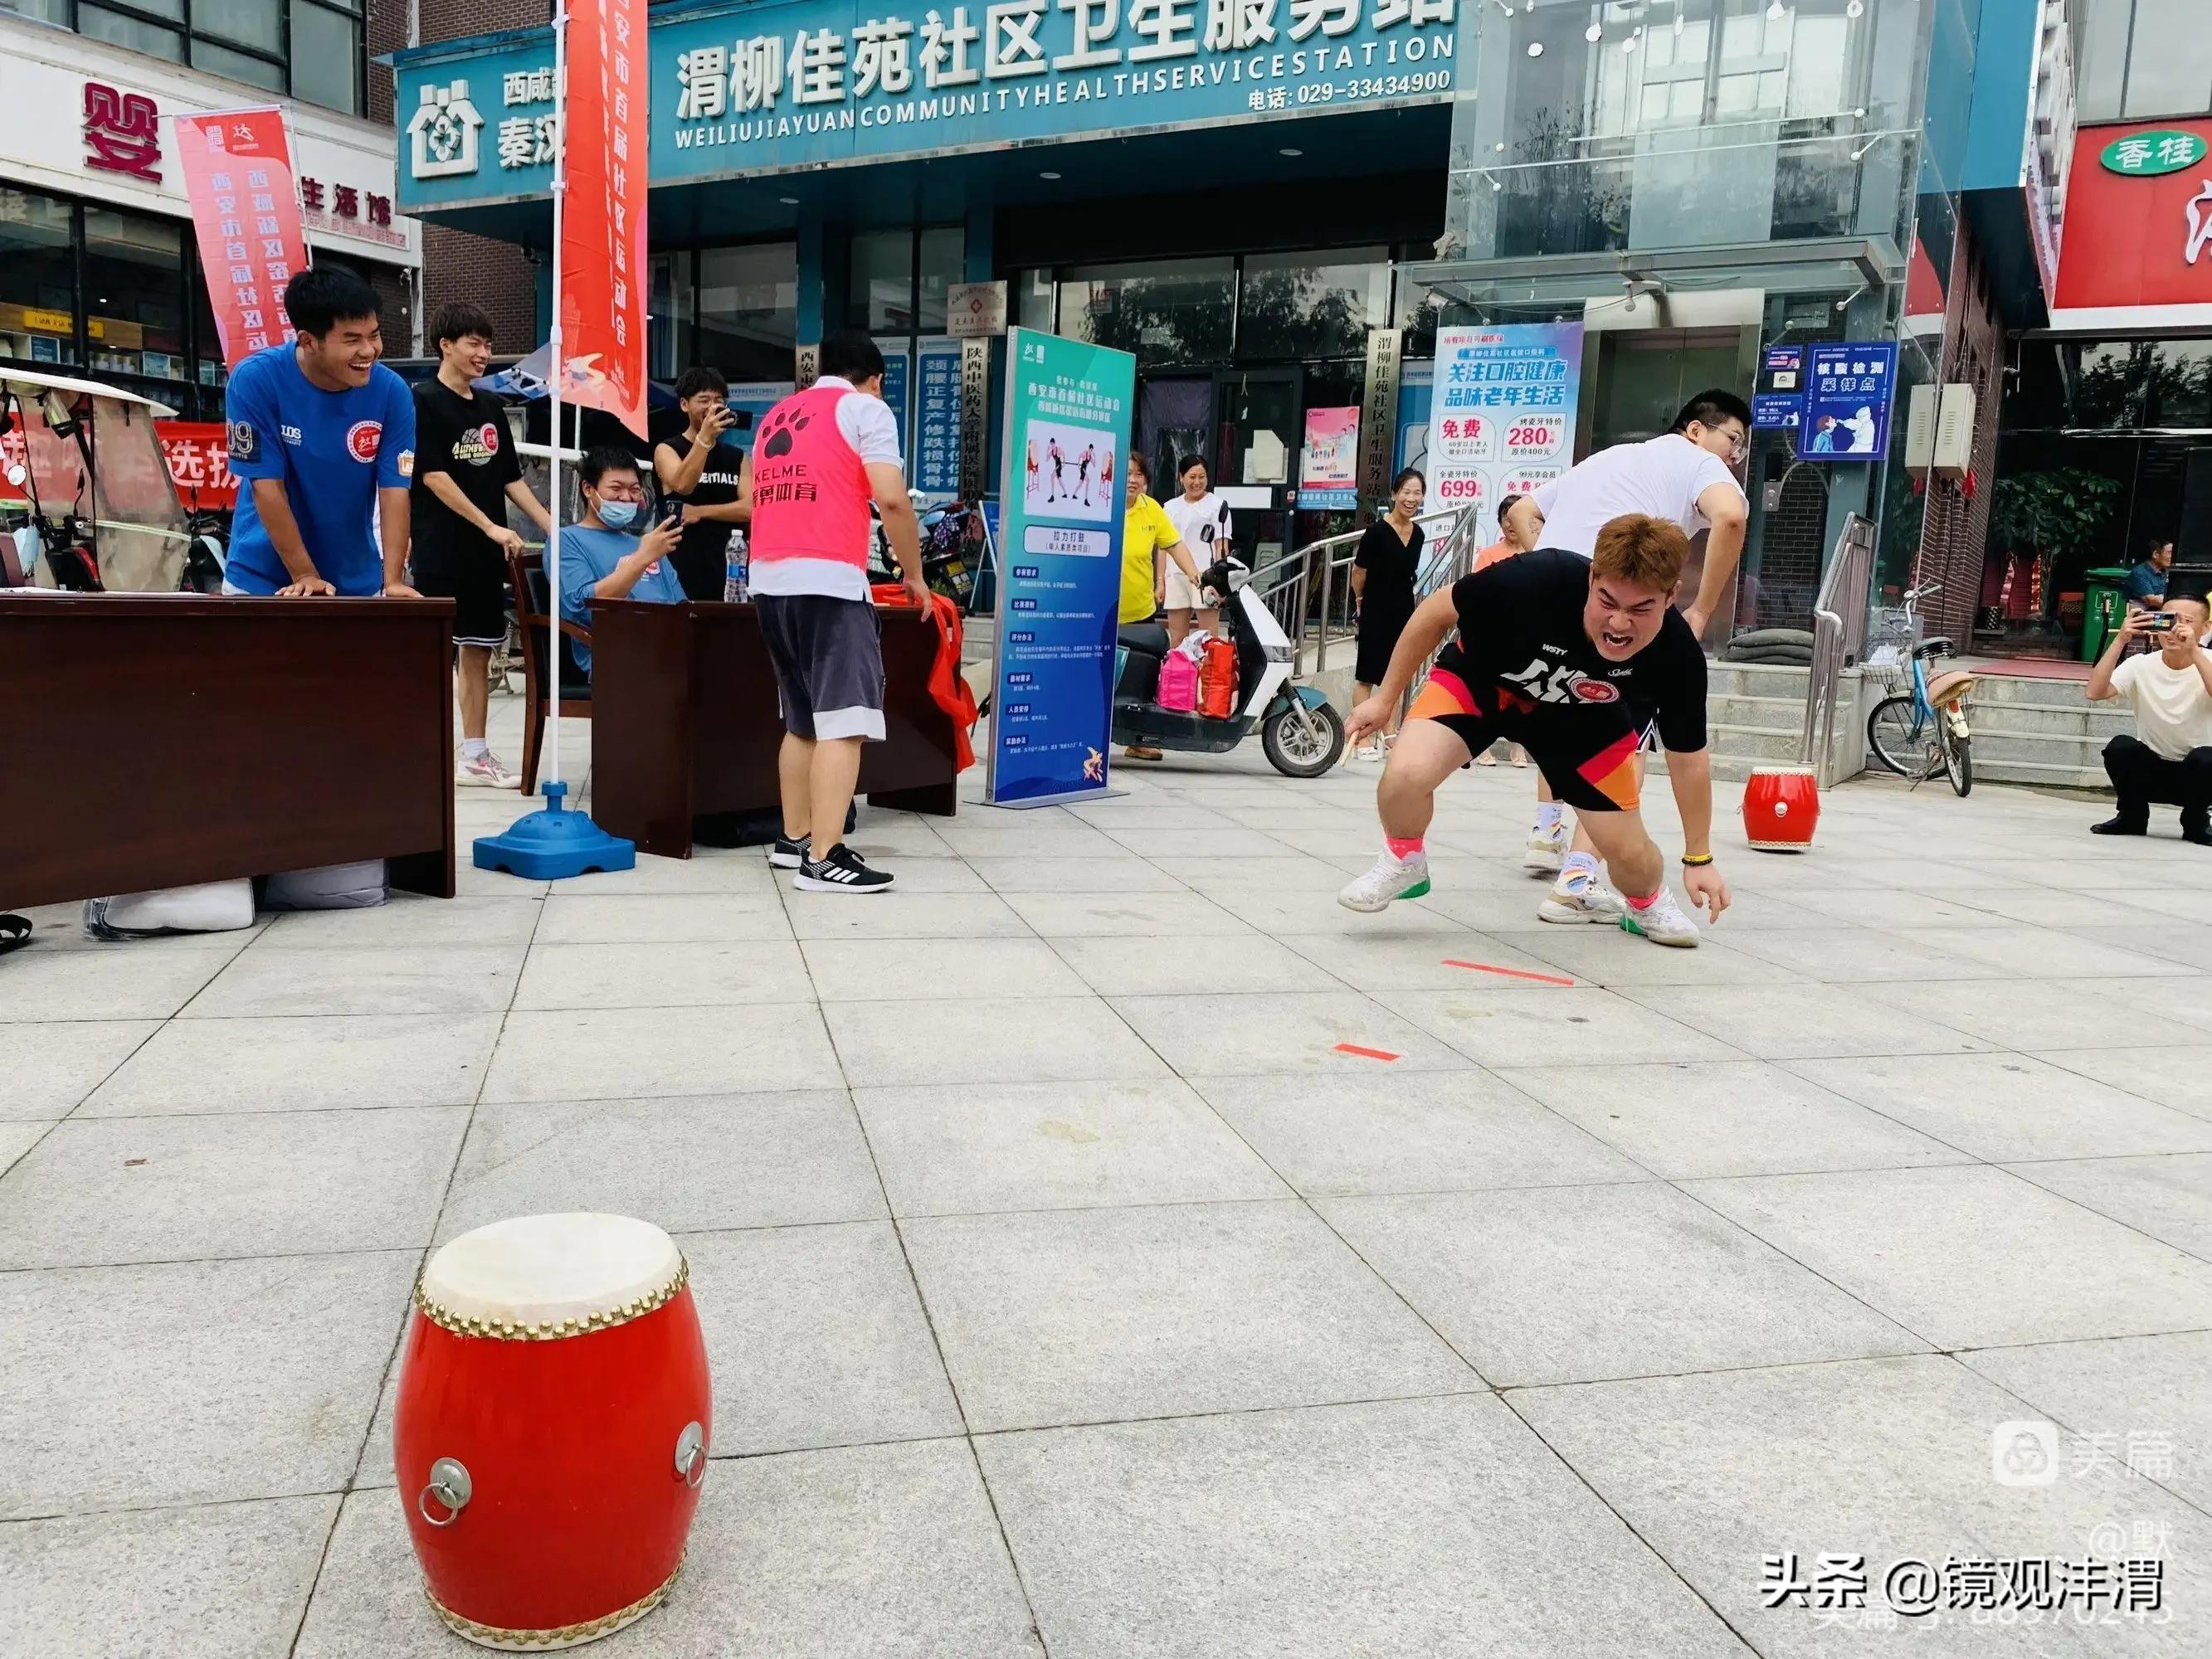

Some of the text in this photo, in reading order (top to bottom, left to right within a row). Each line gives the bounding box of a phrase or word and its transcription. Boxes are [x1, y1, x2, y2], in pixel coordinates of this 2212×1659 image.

[82, 82, 163, 183] 婴
[2116, 135, 2195, 168] 香桂
[613, 0, 629, 347] 安市首届社区运动会
[1449, 361, 1566, 382] 关注口腔健康
[1817, 361, 1884, 376] 核酸检测
[1820, 377, 1875, 392] 采样点
[1445, 386, 1565, 406] 品味老年生活
[1441, 418, 1481, 440] 免费
[1519, 417, 1562, 426] 烤瓷牙特价
[1508, 427, 1548, 446] 280
[1511, 447, 1552, 456] 原价400元
[754, 465, 807, 484] KELME
[1441, 480, 1478, 498] 699
[1053, 531, 1085, 542] 拉力打鼓
